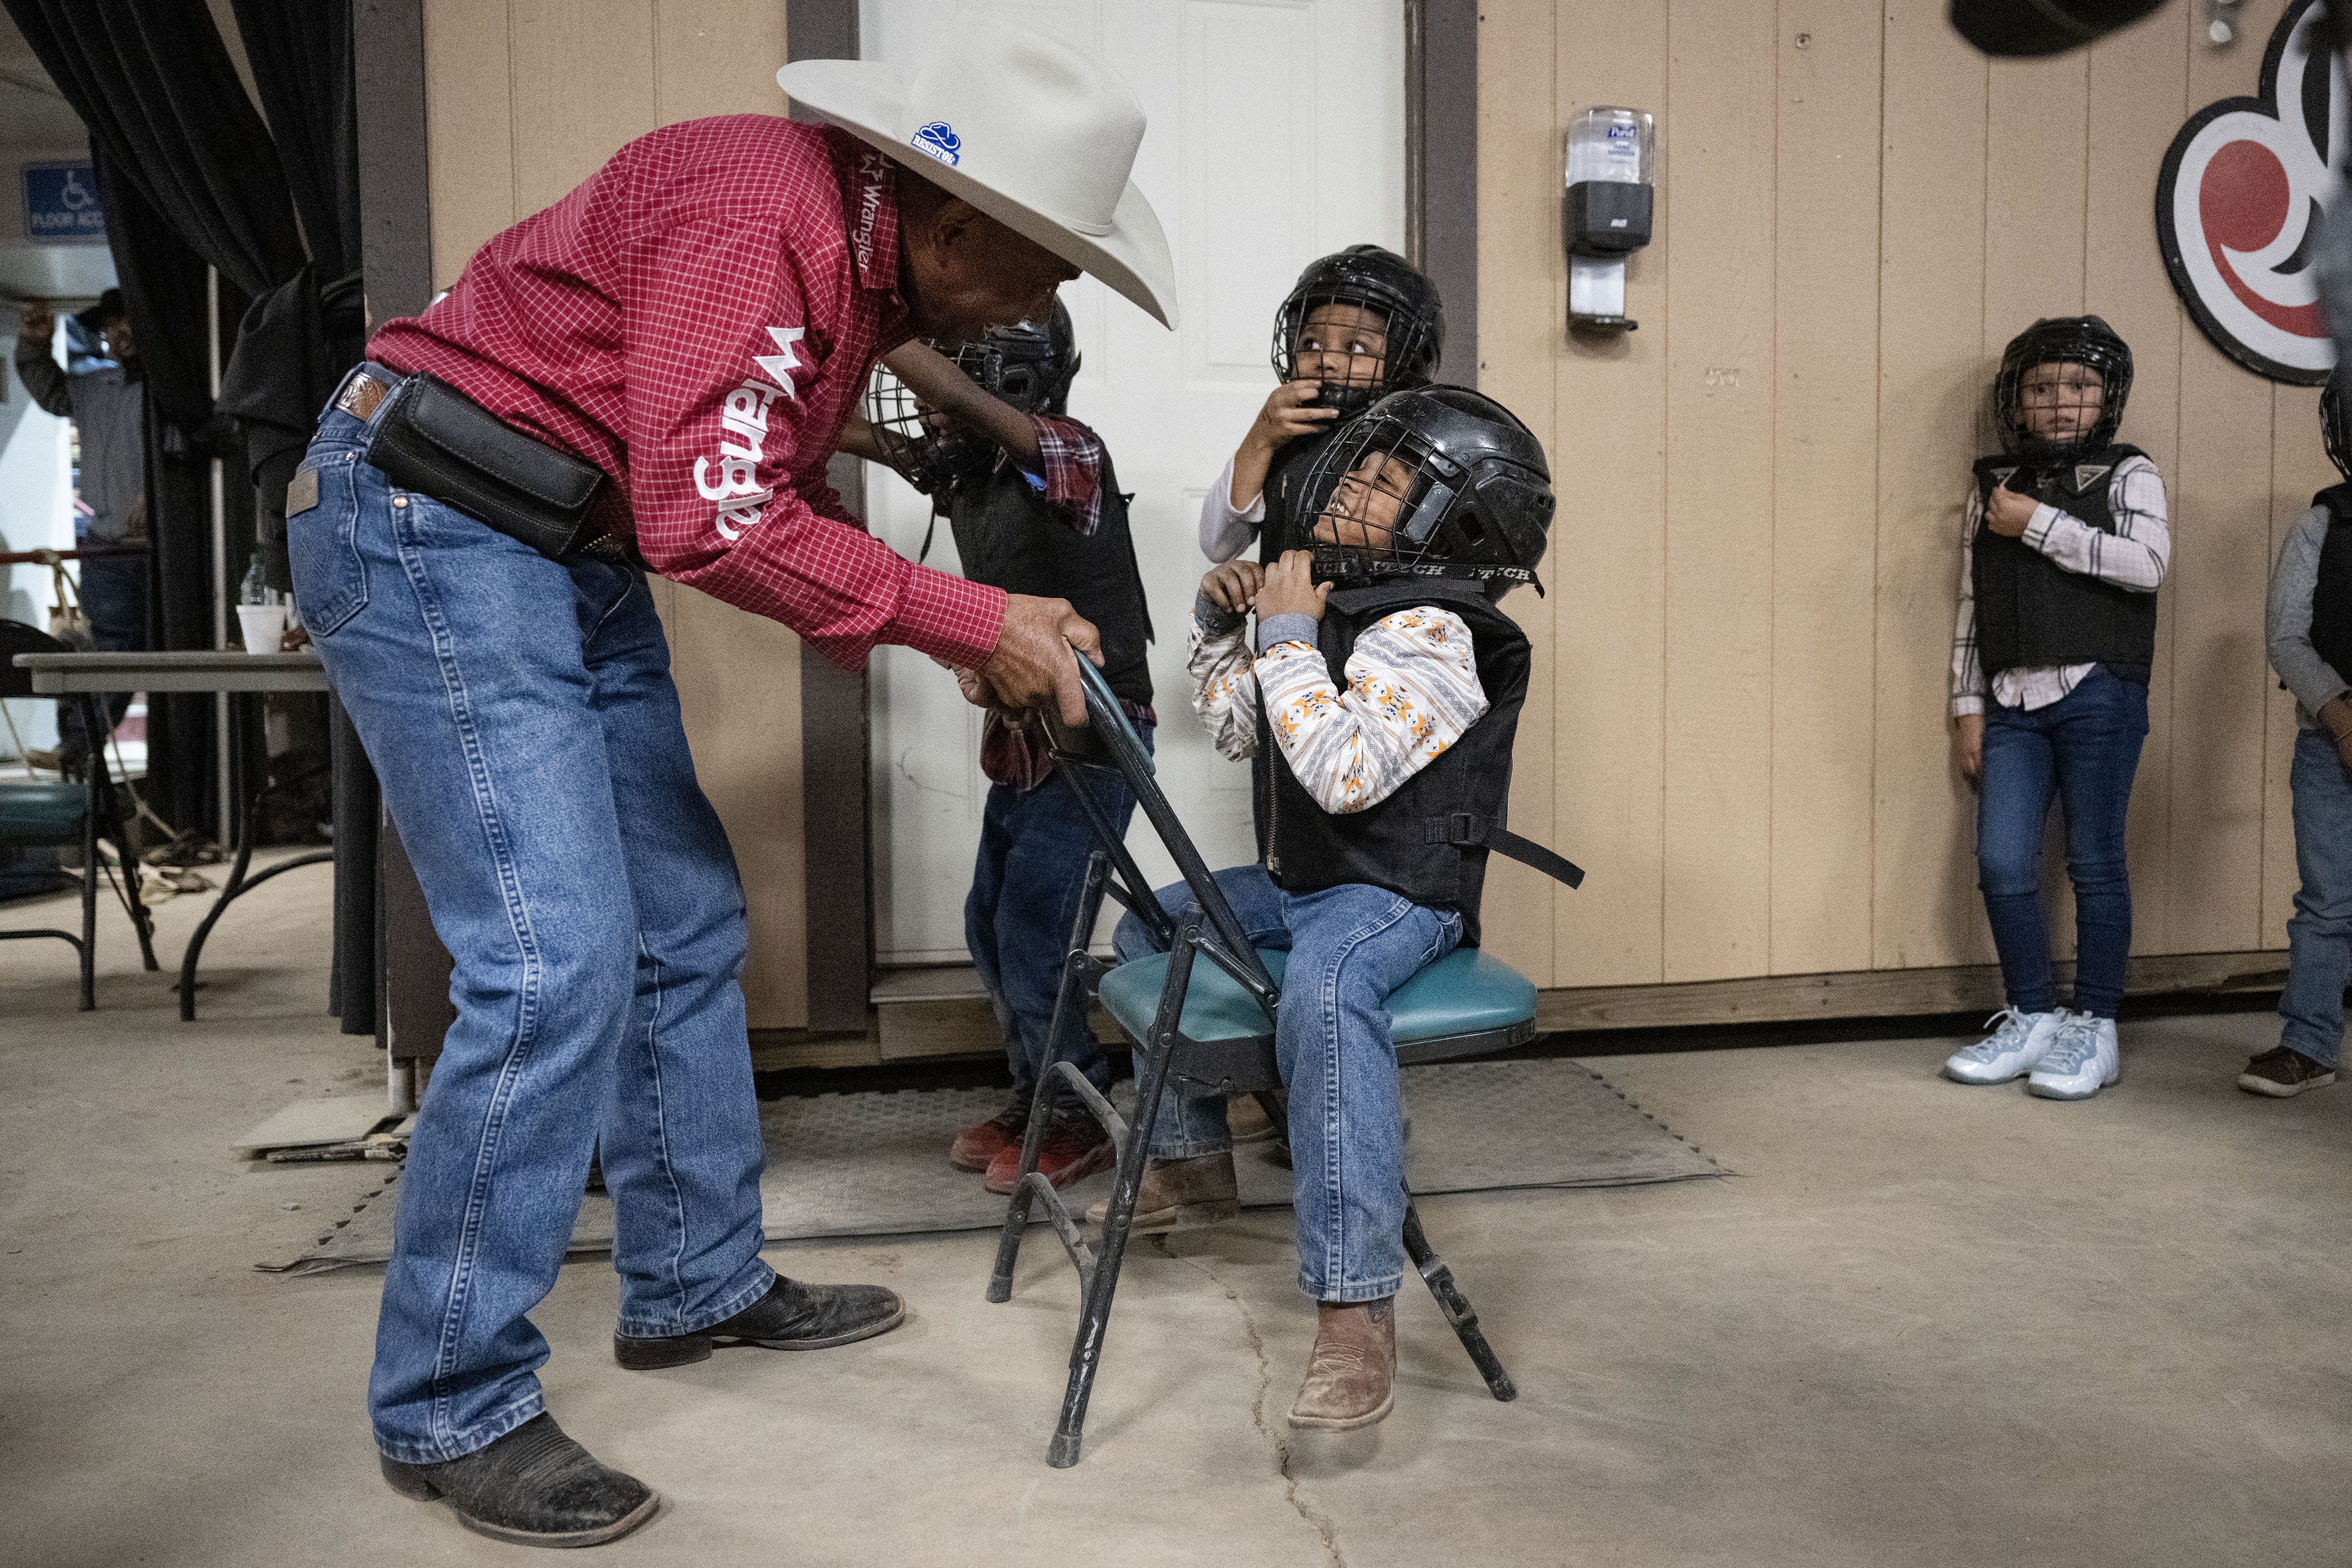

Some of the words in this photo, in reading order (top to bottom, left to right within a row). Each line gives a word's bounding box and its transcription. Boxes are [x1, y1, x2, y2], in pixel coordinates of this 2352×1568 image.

[912, 134, 954, 165] RESISTOL
[852, 185, 882, 273] Wrangler
[693, 326, 805, 542] Wrangle
